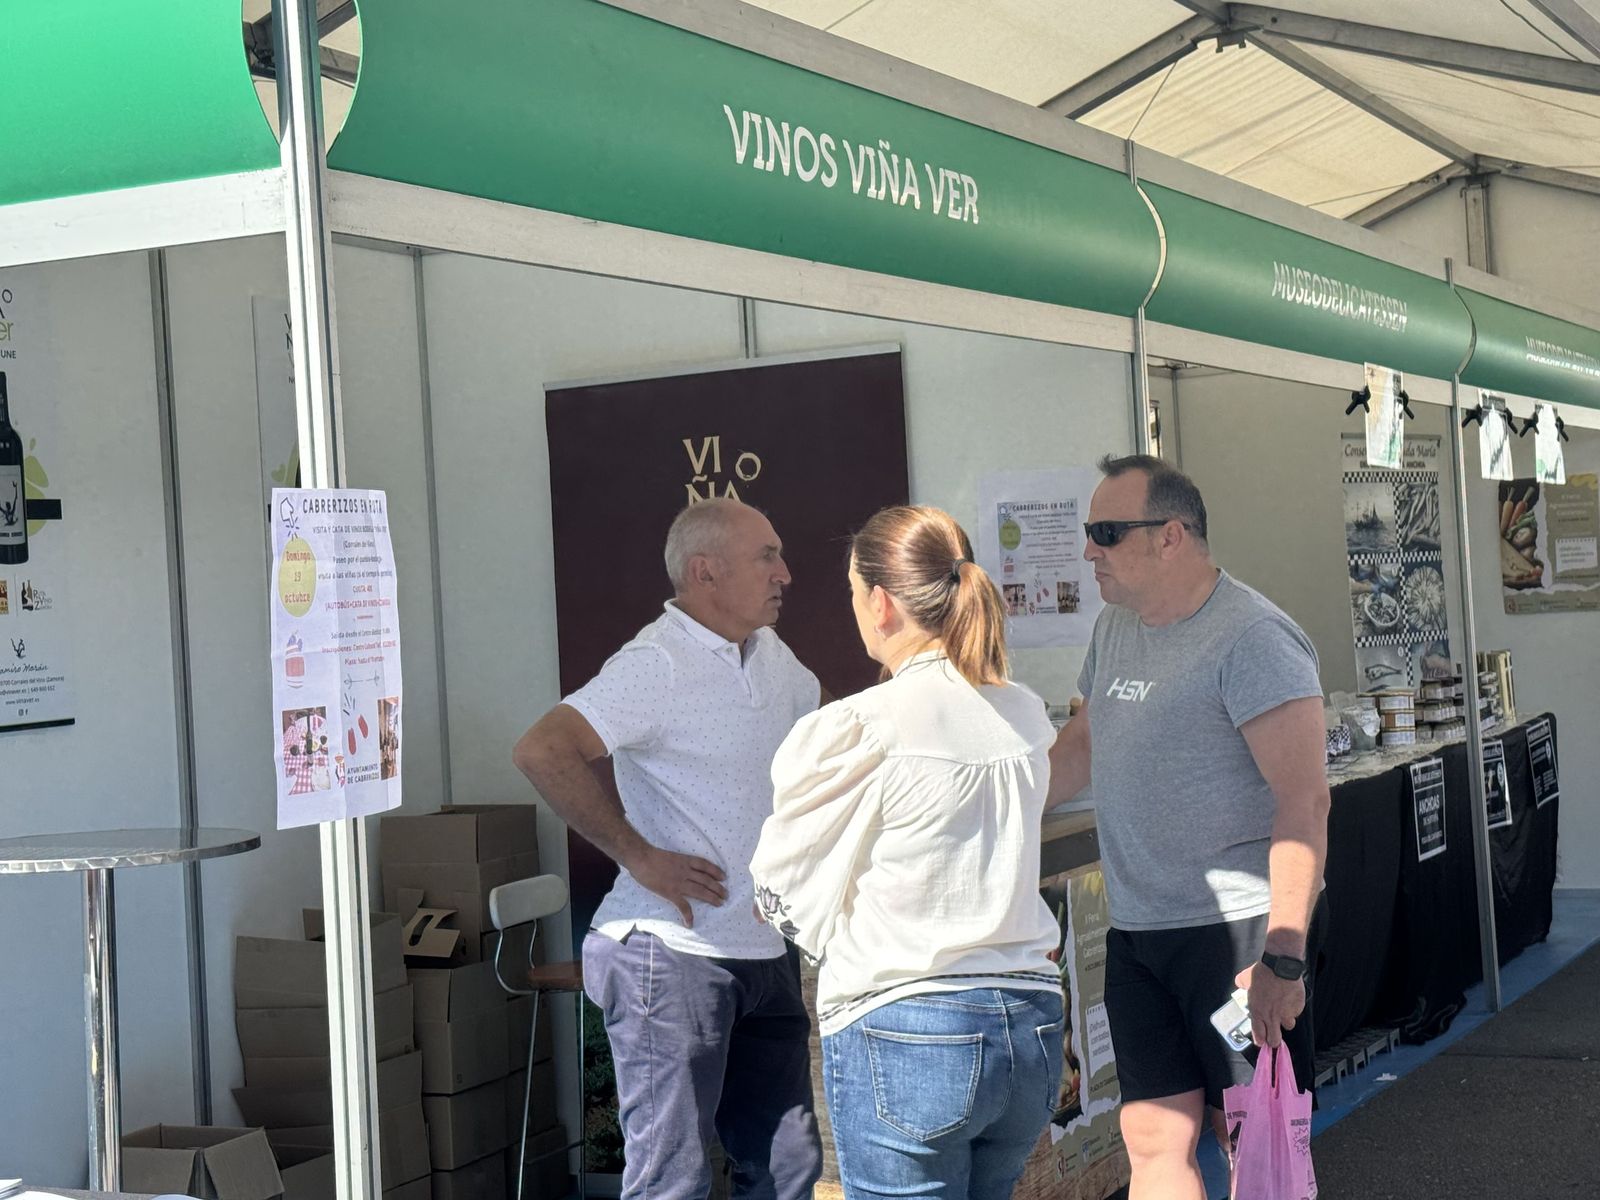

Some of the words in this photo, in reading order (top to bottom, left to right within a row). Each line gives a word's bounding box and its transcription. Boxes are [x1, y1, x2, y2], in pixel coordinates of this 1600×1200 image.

[723, 104, 838, 188] VINOS
[842, 139, 921, 210] VIÑA
[925, 163, 979, 224] VER
[1271, 260, 1407, 333] MUSEODELICATESSEN
[682, 435, 721, 474] VI
[302, 498, 358, 514] CABRERIZOS
[360, 499, 368, 513] EN
[332, 525, 343, 533] CATA
[344, 525, 350, 533] DE
[286, 551, 310, 564] Domingo
[285, 593, 310, 603] octubre
[347, 776, 353, 784] DE
